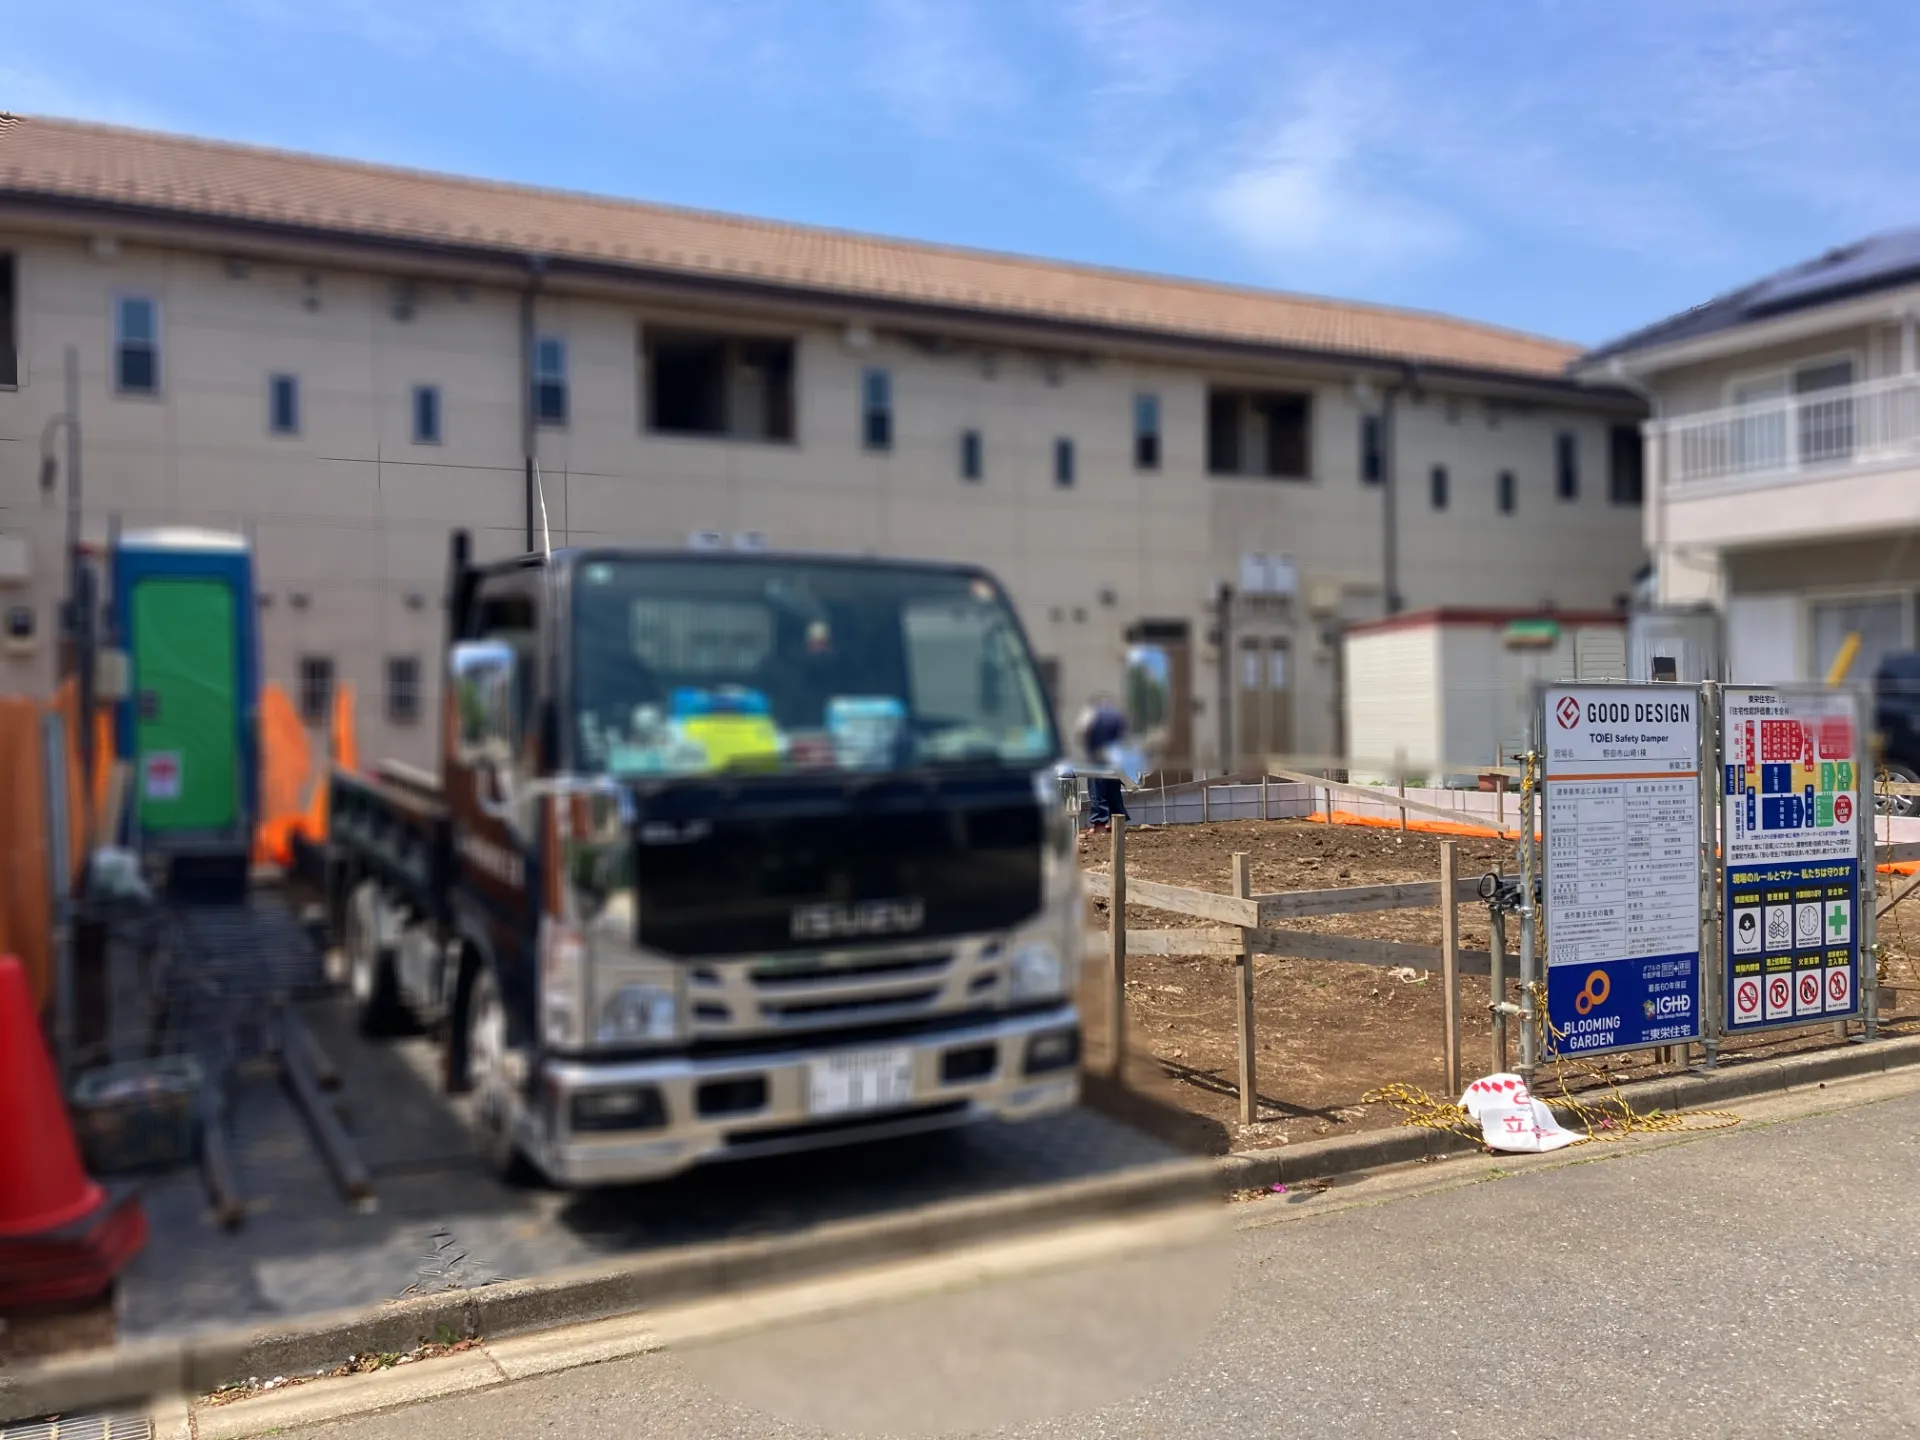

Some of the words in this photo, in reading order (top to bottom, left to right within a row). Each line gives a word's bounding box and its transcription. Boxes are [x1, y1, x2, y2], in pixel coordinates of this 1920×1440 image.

[1587, 703, 1629, 723] GOOD
[1635, 703, 1690, 723] DESIGN
[1615, 734, 1639, 744] Safety
[1641, 734, 1669, 744] Damper
[1732, 870, 1800, 884] 現場のルールとマナー
[1801, 866, 1851, 880] 私たちは守ります
[1648, 981, 1687, 993] 最長60年保証
[1564, 1015, 1621, 1035] BLOOMING
[1650, 1025, 1691, 1040] 東栄住宅
[1570, 1031, 1614, 1050] GARDEN
